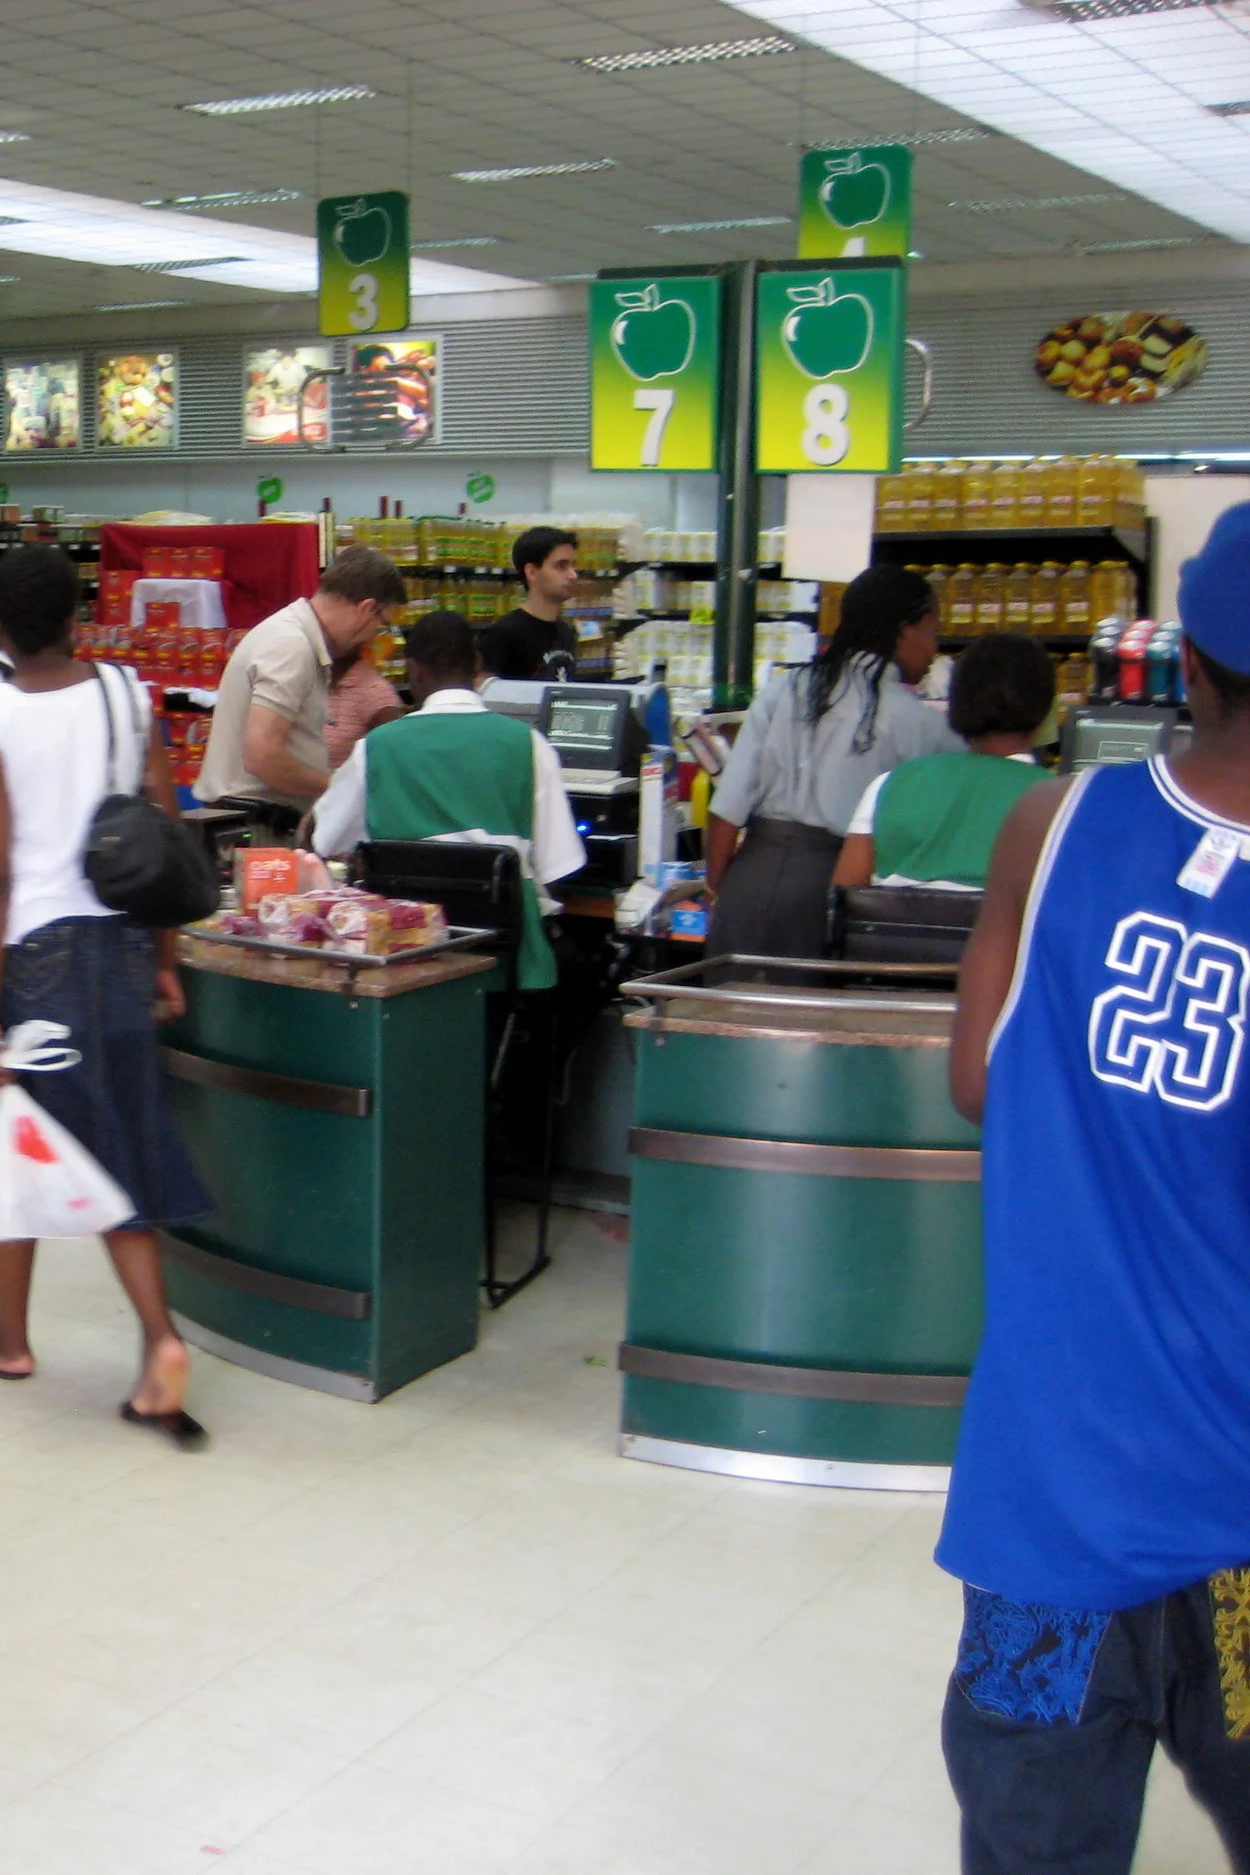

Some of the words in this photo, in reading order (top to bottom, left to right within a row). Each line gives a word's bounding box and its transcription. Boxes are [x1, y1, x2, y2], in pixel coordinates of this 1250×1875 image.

[348, 272, 379, 331] 3
[633, 388, 675, 467] 7
[801, 382, 850, 466] 8
[1087, 910, 1250, 1111] 23
